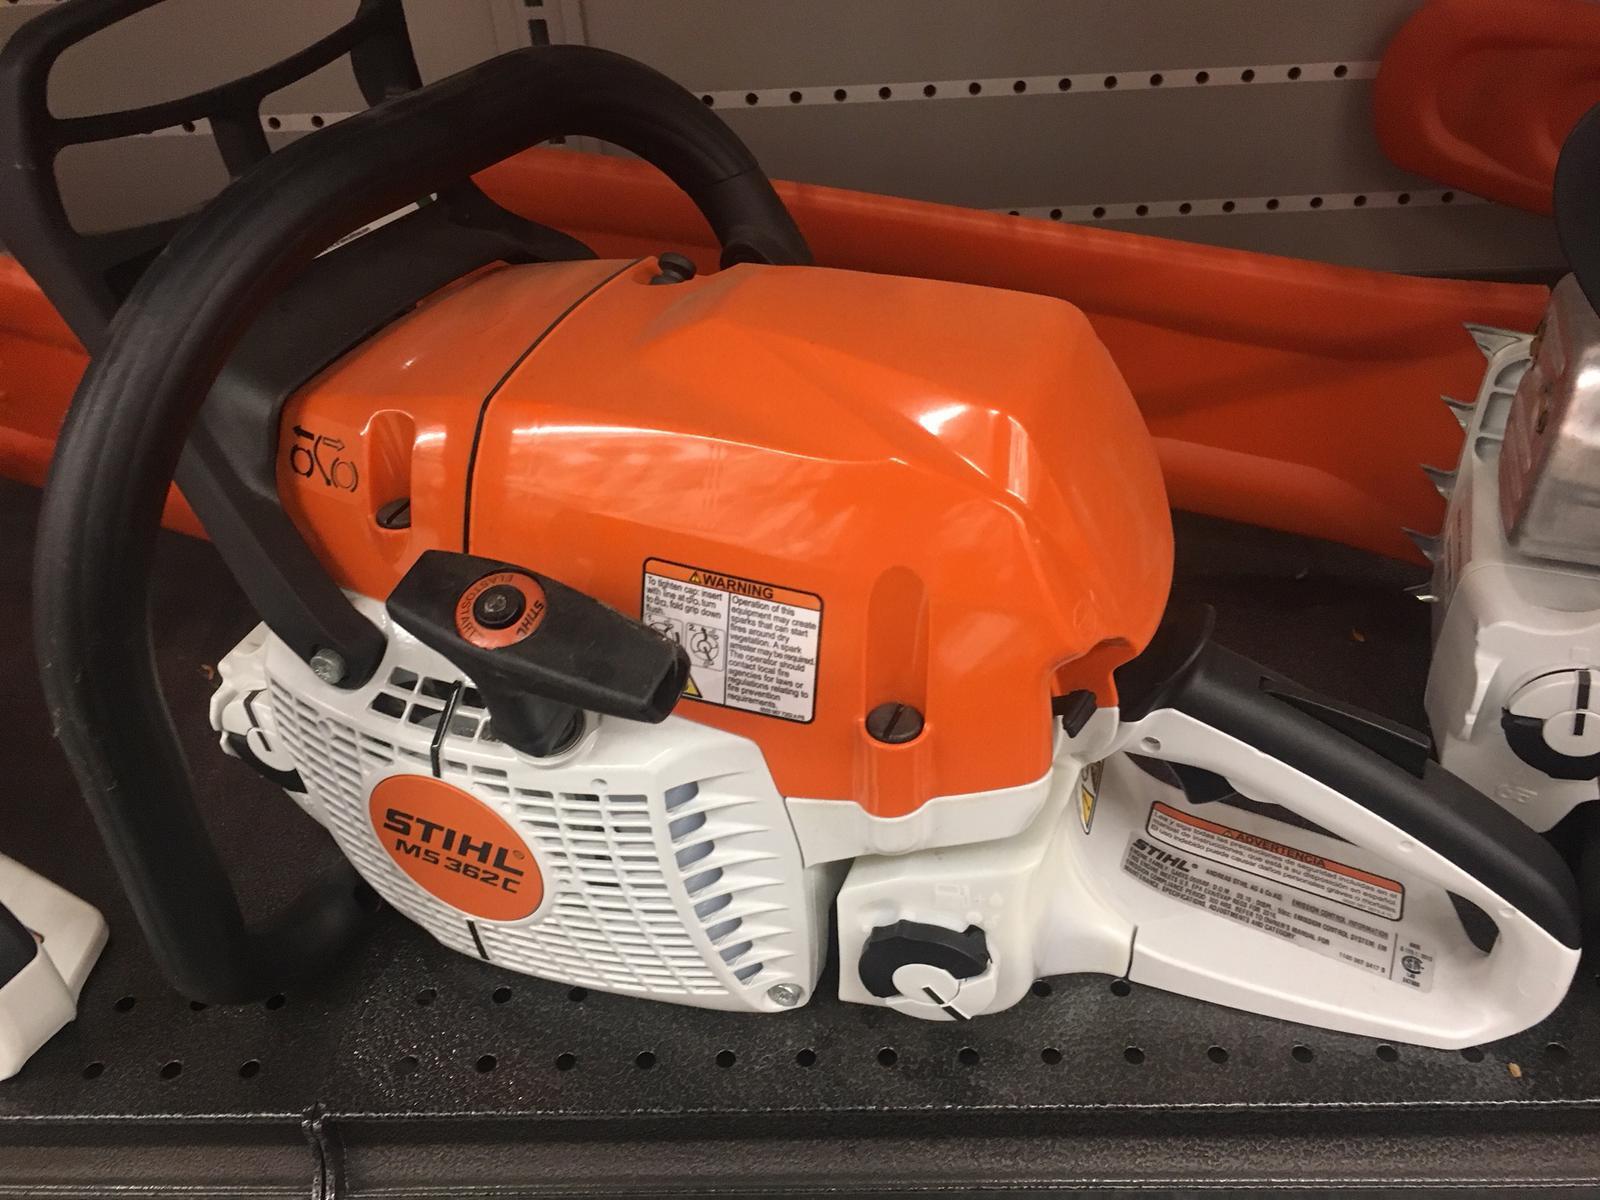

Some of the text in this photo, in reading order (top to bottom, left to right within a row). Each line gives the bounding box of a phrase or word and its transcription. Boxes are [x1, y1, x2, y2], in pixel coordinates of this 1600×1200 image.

[647, 575, 655, 585] To
[657, 578, 682, 593] tighten
[701, 590, 722, 600] insert
[647, 585, 716, 608] with line at turn
[702, 574, 773, 598] WARNING
[646, 594, 721, 619] to fold grip down
[731, 605, 816, 629] equipment may create
[732, 595, 794, 616] Operation of this
[515, 599, 545, 637] STIHL
[731, 614, 808, 637] sparks that can start
[730, 622, 789, 644] fires around dry
[730, 632, 769, 648] vegetation.
[780, 642, 801, 654] spark
[729, 642, 755, 653] arrester
[757, 647, 772, 658] may
[729, 649, 805, 672] The operator should
[728, 658, 789, 677] contact local fire
[728, 667, 803, 689] agencies for laws or
[727, 682, 780, 702] fire prevention
[728, 675, 808, 698] regulations relating to
[383, 807, 524, 877] STIHL
[395, 838, 441, 865] MS
[1152, 818, 1179, 833] manual
[1180, 830, 1191, 838] de
[1247, 853, 1263, 862] que
[1264, 858, 1282, 868] está
[1302, 871, 1348, 890] disposición
[1153, 811, 1168, 821] Lea
[1175, 822, 1192, 832] siga
[1193, 828, 1215, 839] todas
[1230, 841, 1283, 861] precauciones
[1297, 863, 1336, 879] seguridad
[1338, 875, 1375, 891] incluidas
[1236, 833, 1326, 868] ADVERTENCIA
[1132, 838, 1191, 873] STIHL
[1150, 823, 1158, 831] El
[1158, 829, 1173, 838] uso
[1172, 834, 1204, 849] indebido
[1205, 846, 1229, 857] puede
[1230, 854, 1256, 866] causar
[1257, 863, 1281, 875] daños
[1282, 872, 1325, 889] personales
[1326, 886, 1353, 899] graves
[1159, 870, 1178, 882] MEETS
[1190, 883, 1203, 891] EPA
[1205, 868, 1231, 882] ANDREAS
[1232, 877, 1248, 888] STIHL
[1125, 858, 1149, 875] EMISSION
[1149, 872, 1183, 892] COMPLIANCE
[1234, 906, 1253, 917] REFER
[1290, 926, 1316, 940] MANUAL
[1316, 935, 1330, 945] FOR
[1208, 903, 1250, 923] ADJUSTMENTS
[1250, 919, 1263, 928] AND
[1290, 898, 1389, 939] EMISSION CONTROL INFORMATION
[1292, 912, 1321, 928] EMISSION
[1321, 922, 1349, 938] CONTROL
